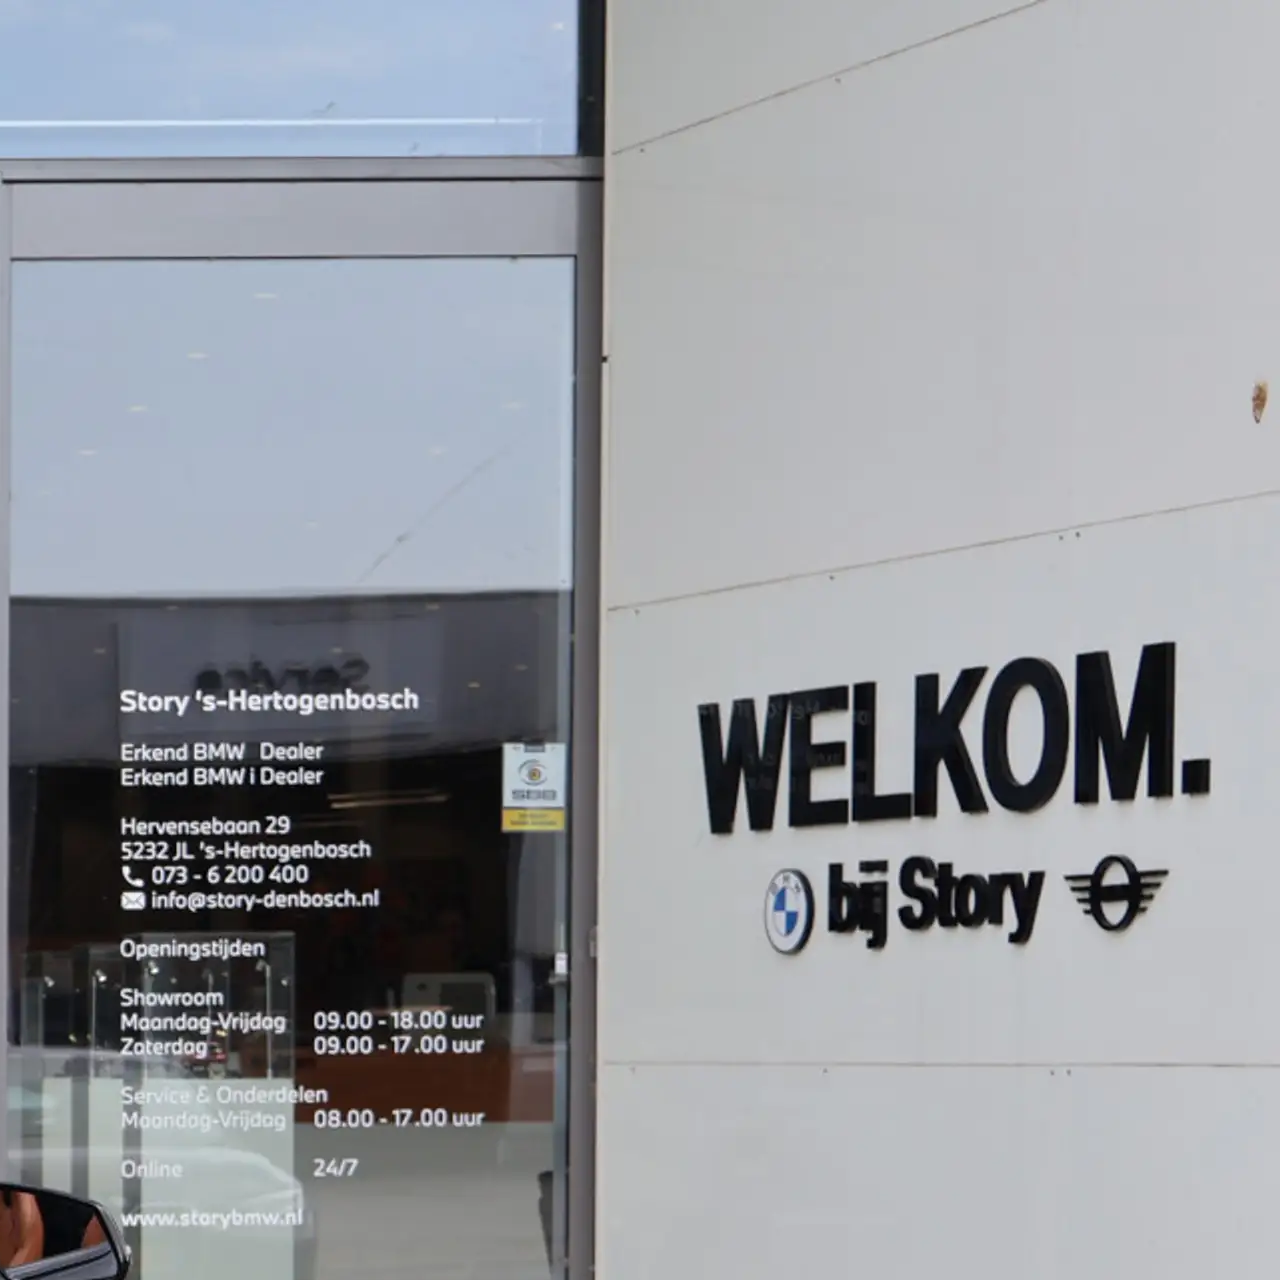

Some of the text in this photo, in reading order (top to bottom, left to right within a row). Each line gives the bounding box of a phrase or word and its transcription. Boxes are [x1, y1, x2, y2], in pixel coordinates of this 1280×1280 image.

[120, 688, 419, 716] Story 's-Hertogenbosch
[697, 641, 1211, 835] WELKOM.
[121, 743, 323, 761] Erkend BMW Dealer
[121, 767, 323, 786] Erkend BMW i Dealer
[121, 816, 290, 835] Hervensebaan 29
[121, 840, 371, 863] 5232 JL 's-Hertogenbosch
[151, 866, 188, 884] 073
[207, 866, 219, 884] 6
[224, 866, 264, 884] 200
[269, 866, 308, 883] 400
[151, 889, 380, 912] info@story-denbosch.nl
[828, 855, 1046, 949] bij Story
[120, 939, 265, 961] Openingstijden
[120, 989, 224, 1006] Showroom
[120, 1013, 287, 1034] Maandag-Vrijdag
[313, 1012, 373, 1030] 09.00
[391, 1011, 446, 1029] 18.00
[451, 1014, 484, 1029] uur
[120, 1038, 208, 1059] Zaterdag
[313, 1036, 373, 1055] 09.00
[391, 1036, 446, 1054] 17.00
[452, 1039, 484, 1054] uur
[120, 1086, 328, 1104] Service & Onderdelen
[121, 1111, 286, 1133] Maandag-Vrijdag
[314, 1110, 373, 1128] 08.00
[392, 1109, 446, 1127] 17.00
[452, 1113, 485, 1127] uur
[121, 1158, 358, 1178] Online 24/7
[121, 1209, 303, 1230] www.storybmw.nl
